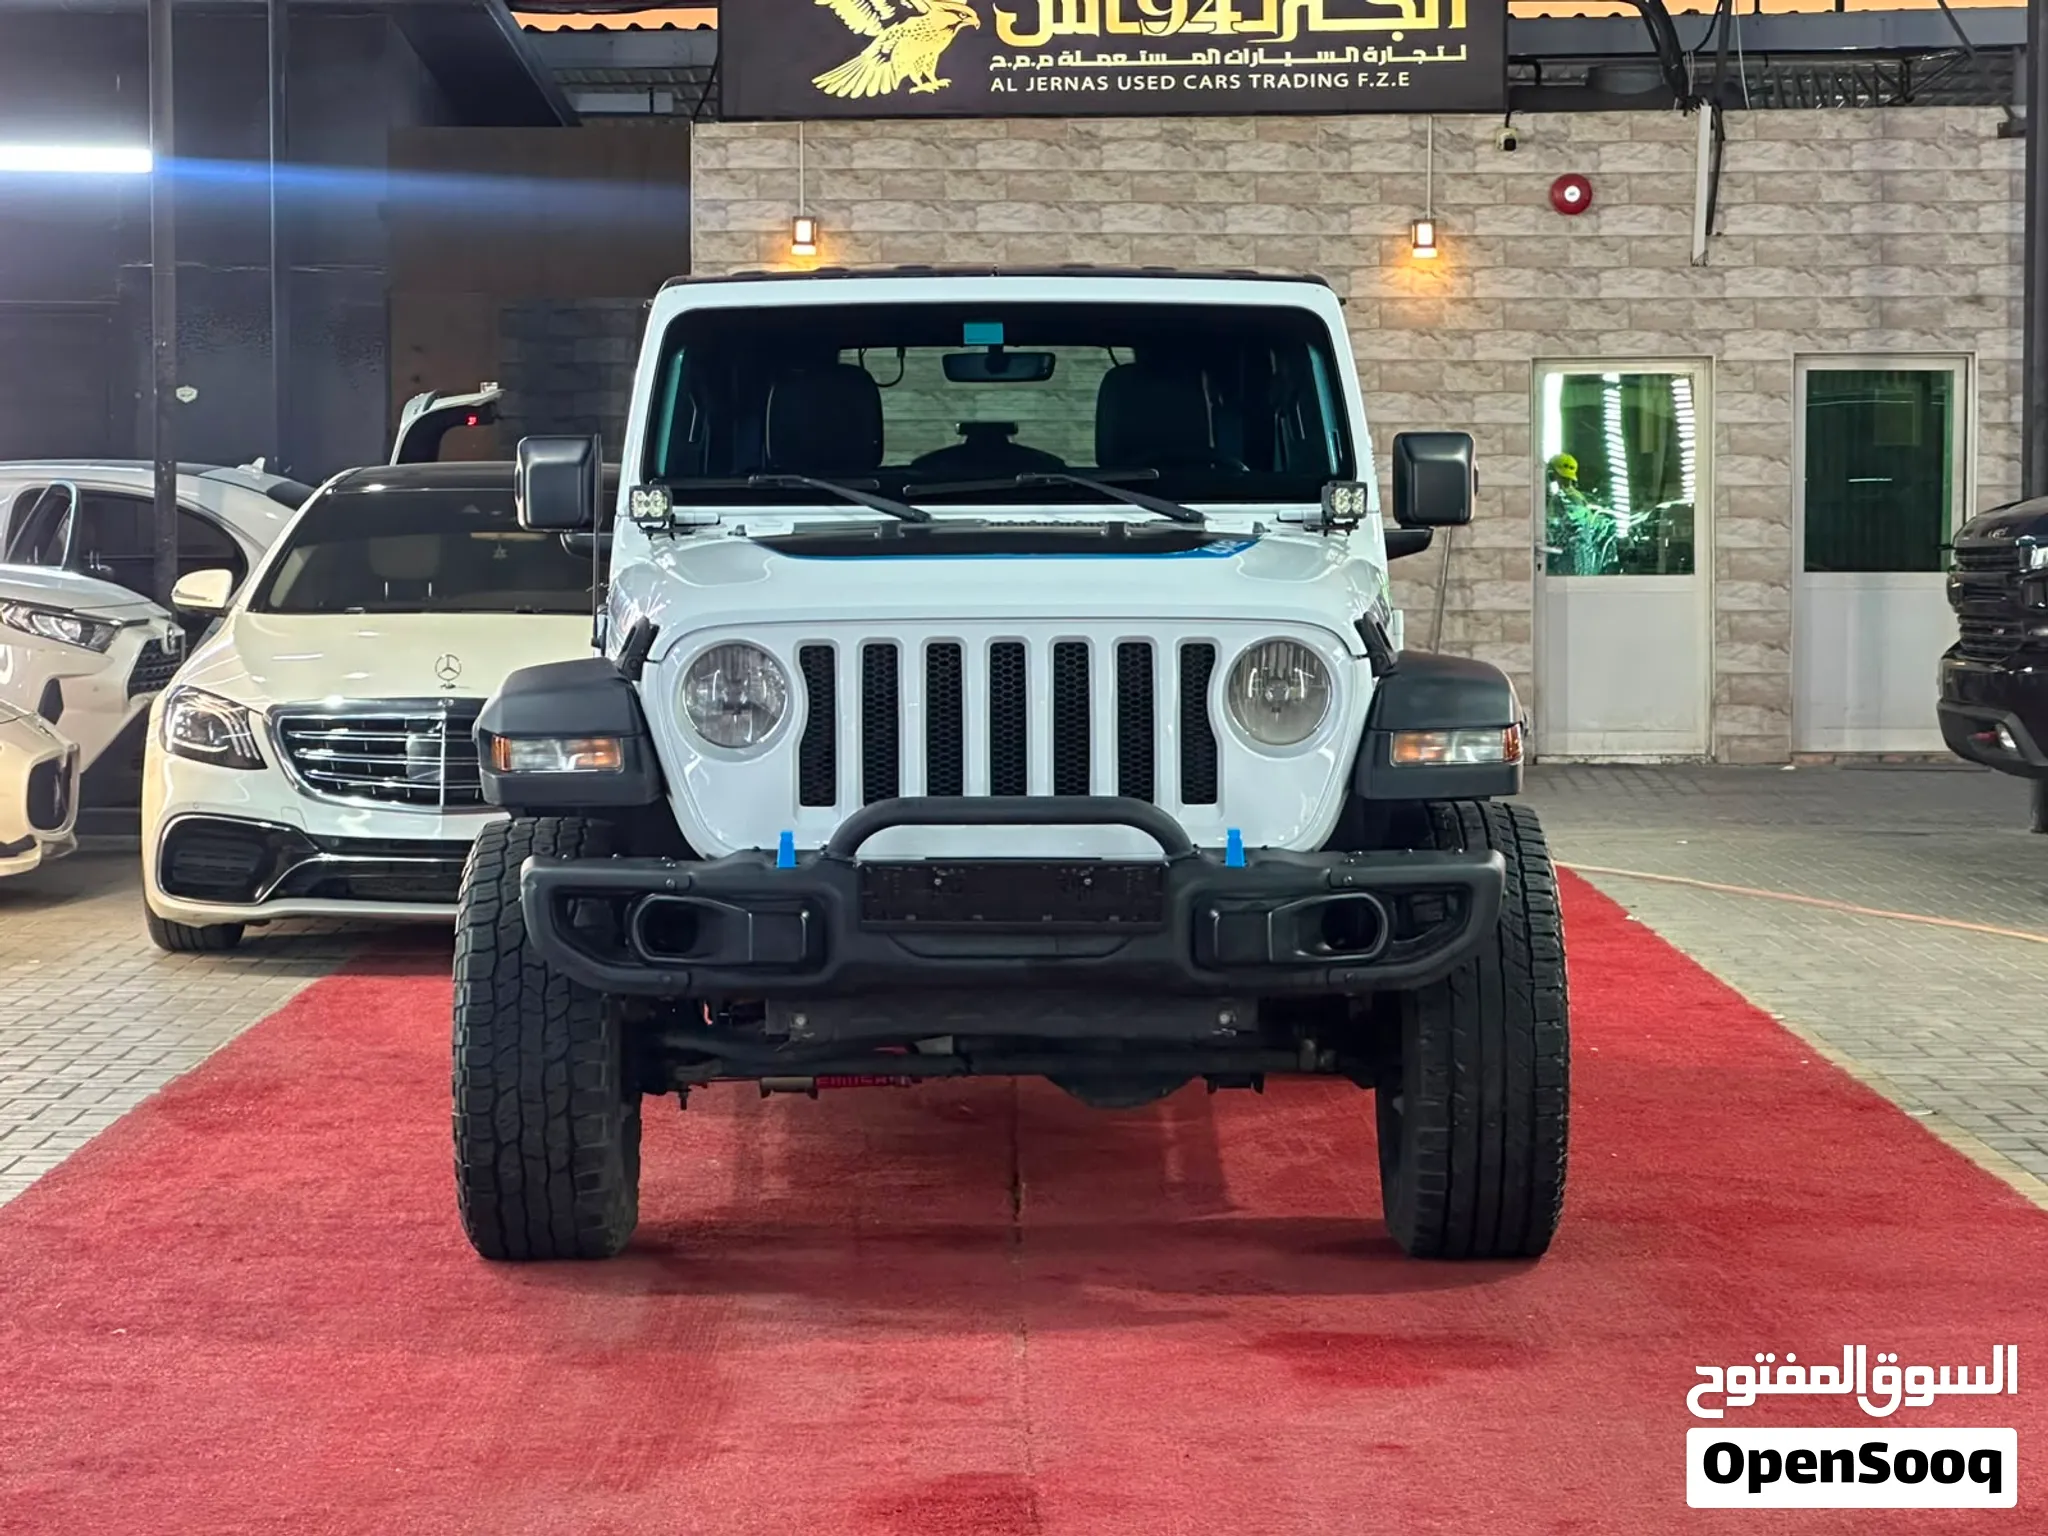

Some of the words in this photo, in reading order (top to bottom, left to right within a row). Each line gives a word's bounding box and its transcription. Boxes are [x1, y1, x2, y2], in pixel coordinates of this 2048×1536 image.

[1058, 48, 1221, 67] المستعملة
[1224, 46, 1359, 67] السيارات
[1363, 44, 1467, 65] لتجارة
[990, 77, 1018, 92] AL
[1025, 76, 1109, 92] JERNAS
[1117, 75, 1176, 91] USED
[1183, 74, 1241, 90] CARS
[1247, 73, 1349, 89] TRADING
[1357, 72, 1411, 88] F.Z.E
